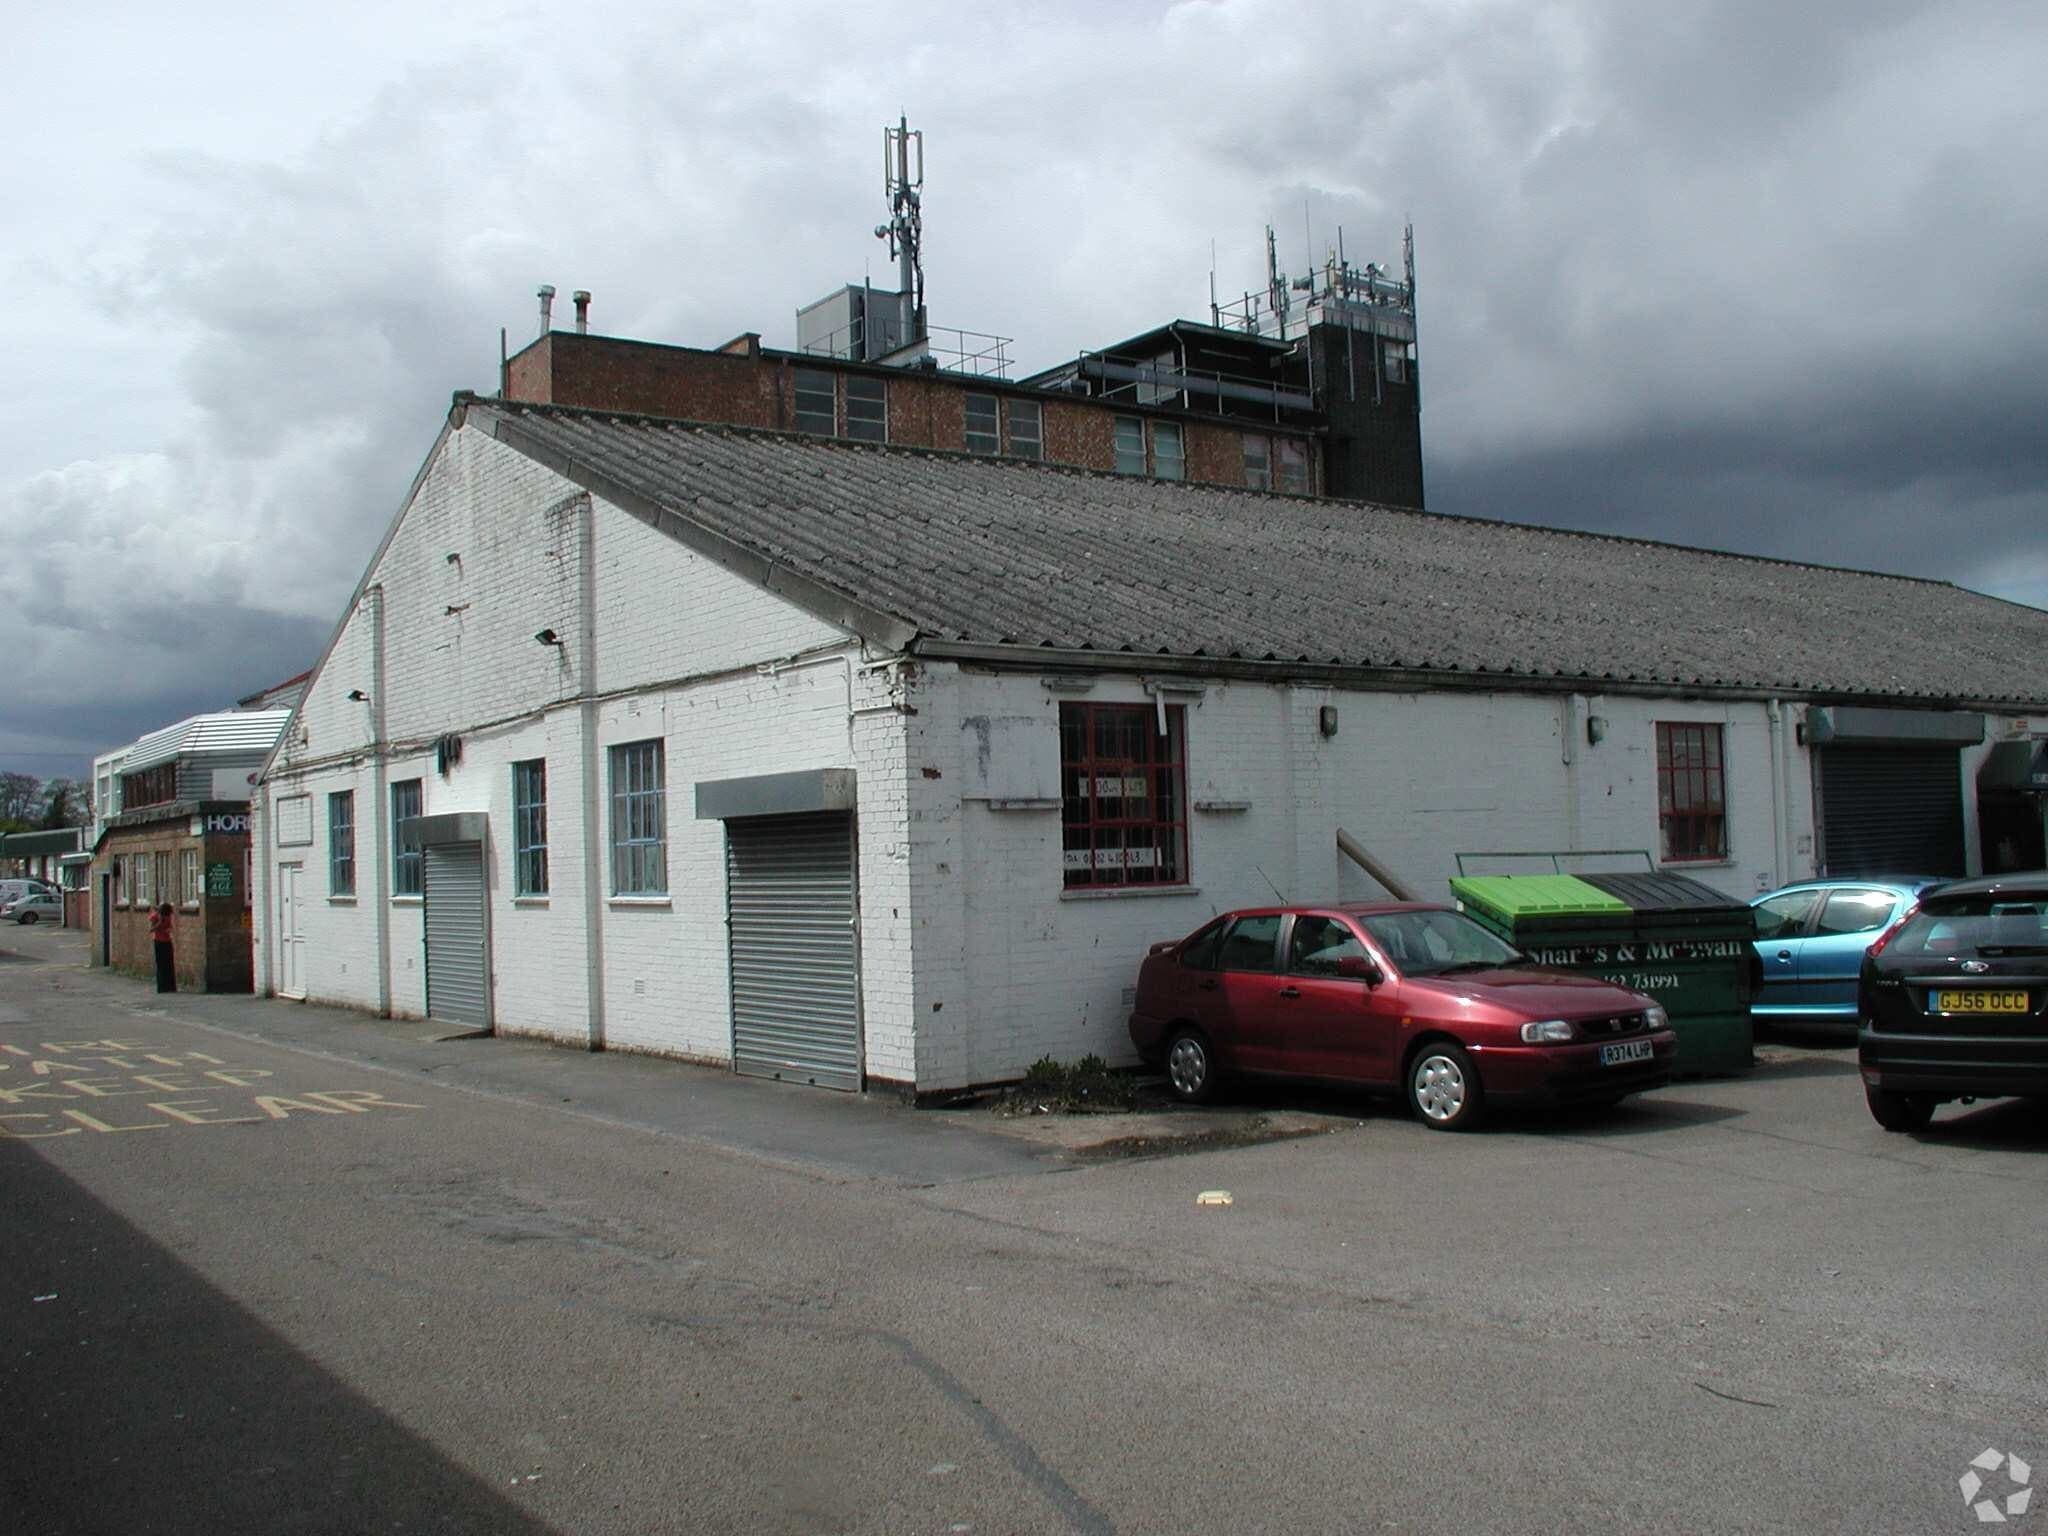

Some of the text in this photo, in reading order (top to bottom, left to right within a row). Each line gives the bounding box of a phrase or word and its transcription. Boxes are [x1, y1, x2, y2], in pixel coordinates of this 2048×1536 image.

[1617, 943, 1636, 961] &
[1632, 973, 1680, 989] 731991
[1940, 991, 2025, 1009] GJ56 OCC
[1606, 1045, 1633, 1062] R374
[0, 1070, 273, 1103] KEEP
[0, 1091, 426, 1138] CLEAR
